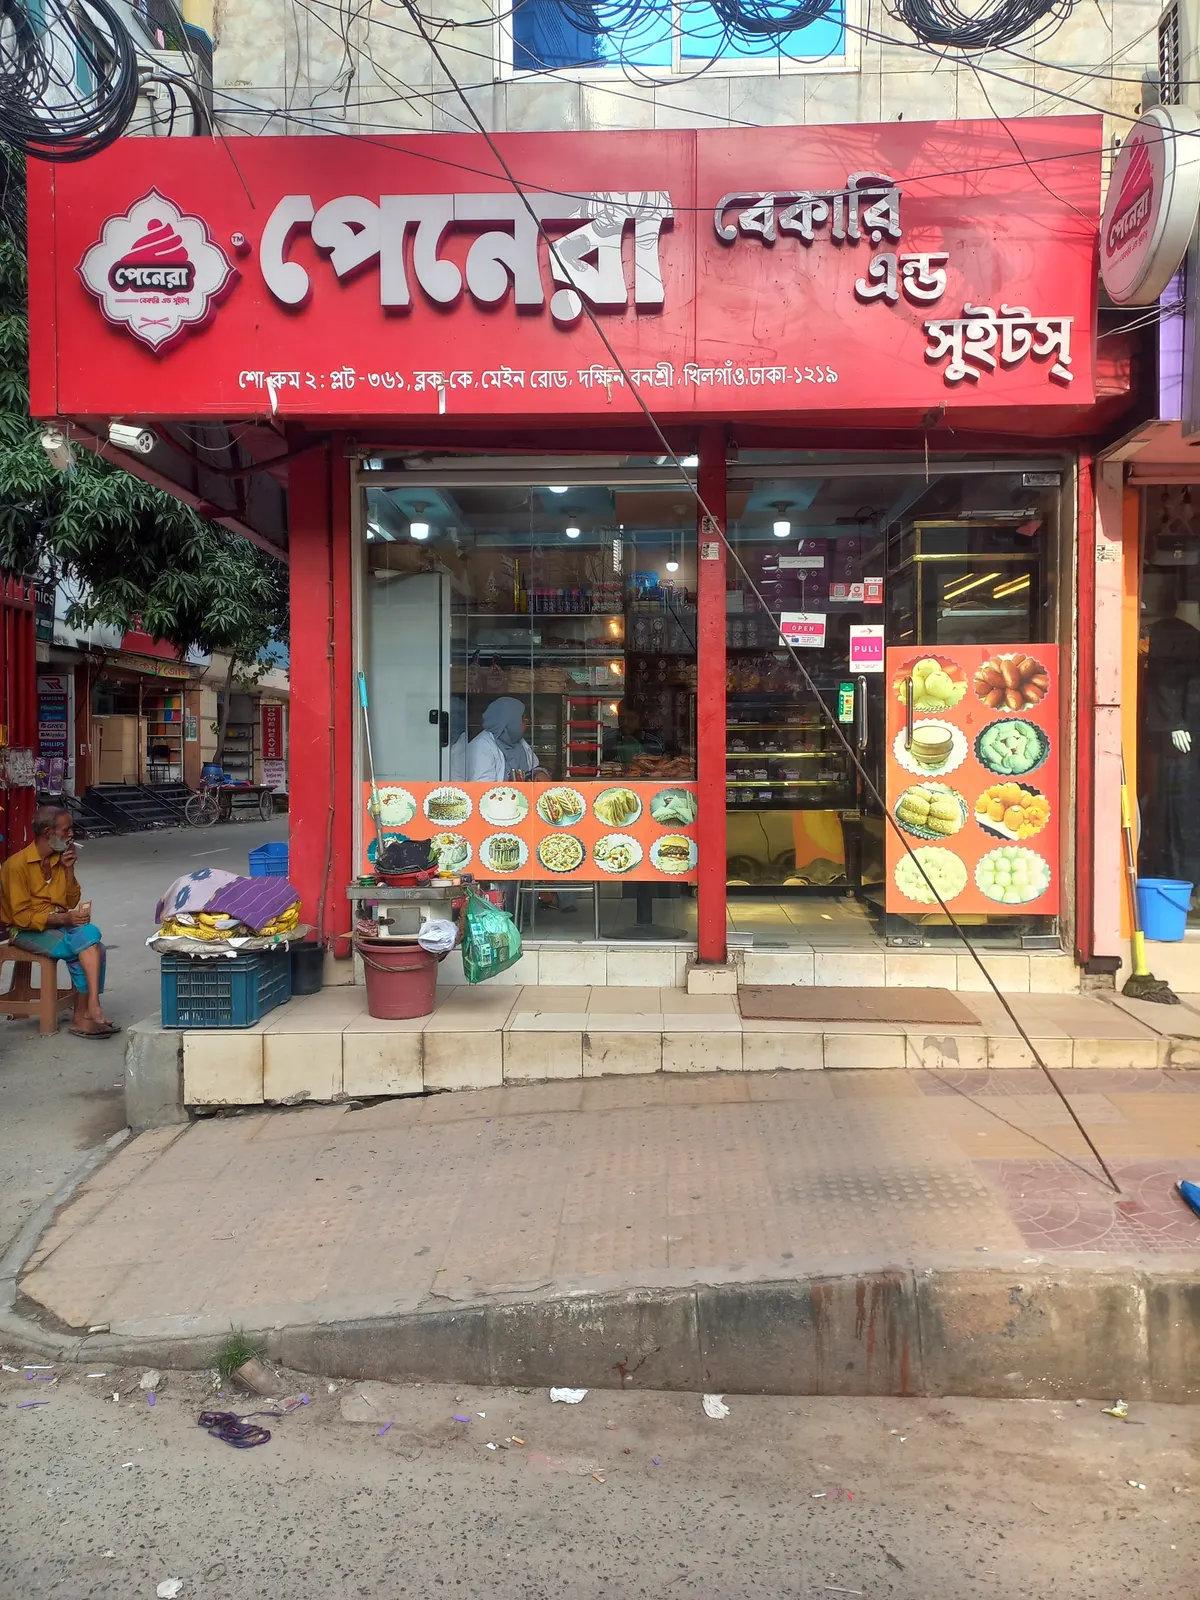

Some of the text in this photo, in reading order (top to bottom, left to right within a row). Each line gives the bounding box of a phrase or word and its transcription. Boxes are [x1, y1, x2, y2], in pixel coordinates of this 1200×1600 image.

[714, 172, 902, 243] বেকারি
[1109, 188, 1150, 248] পেনেরা
[259, 190, 674, 323] পেনেরা
[115, 267, 189, 288] পেনেরা
[855, 252, 949, 303] এন্ড
[924, 303, 1075, 383] সুইটস্
[481, 365, 525, 388] মেইন
[791, 624, 815, 632] OPEN
[854, 645, 880, 653] PULL
[267, 707, 276, 726] HOME
[267, 728, 276, 757] HEAVEN
